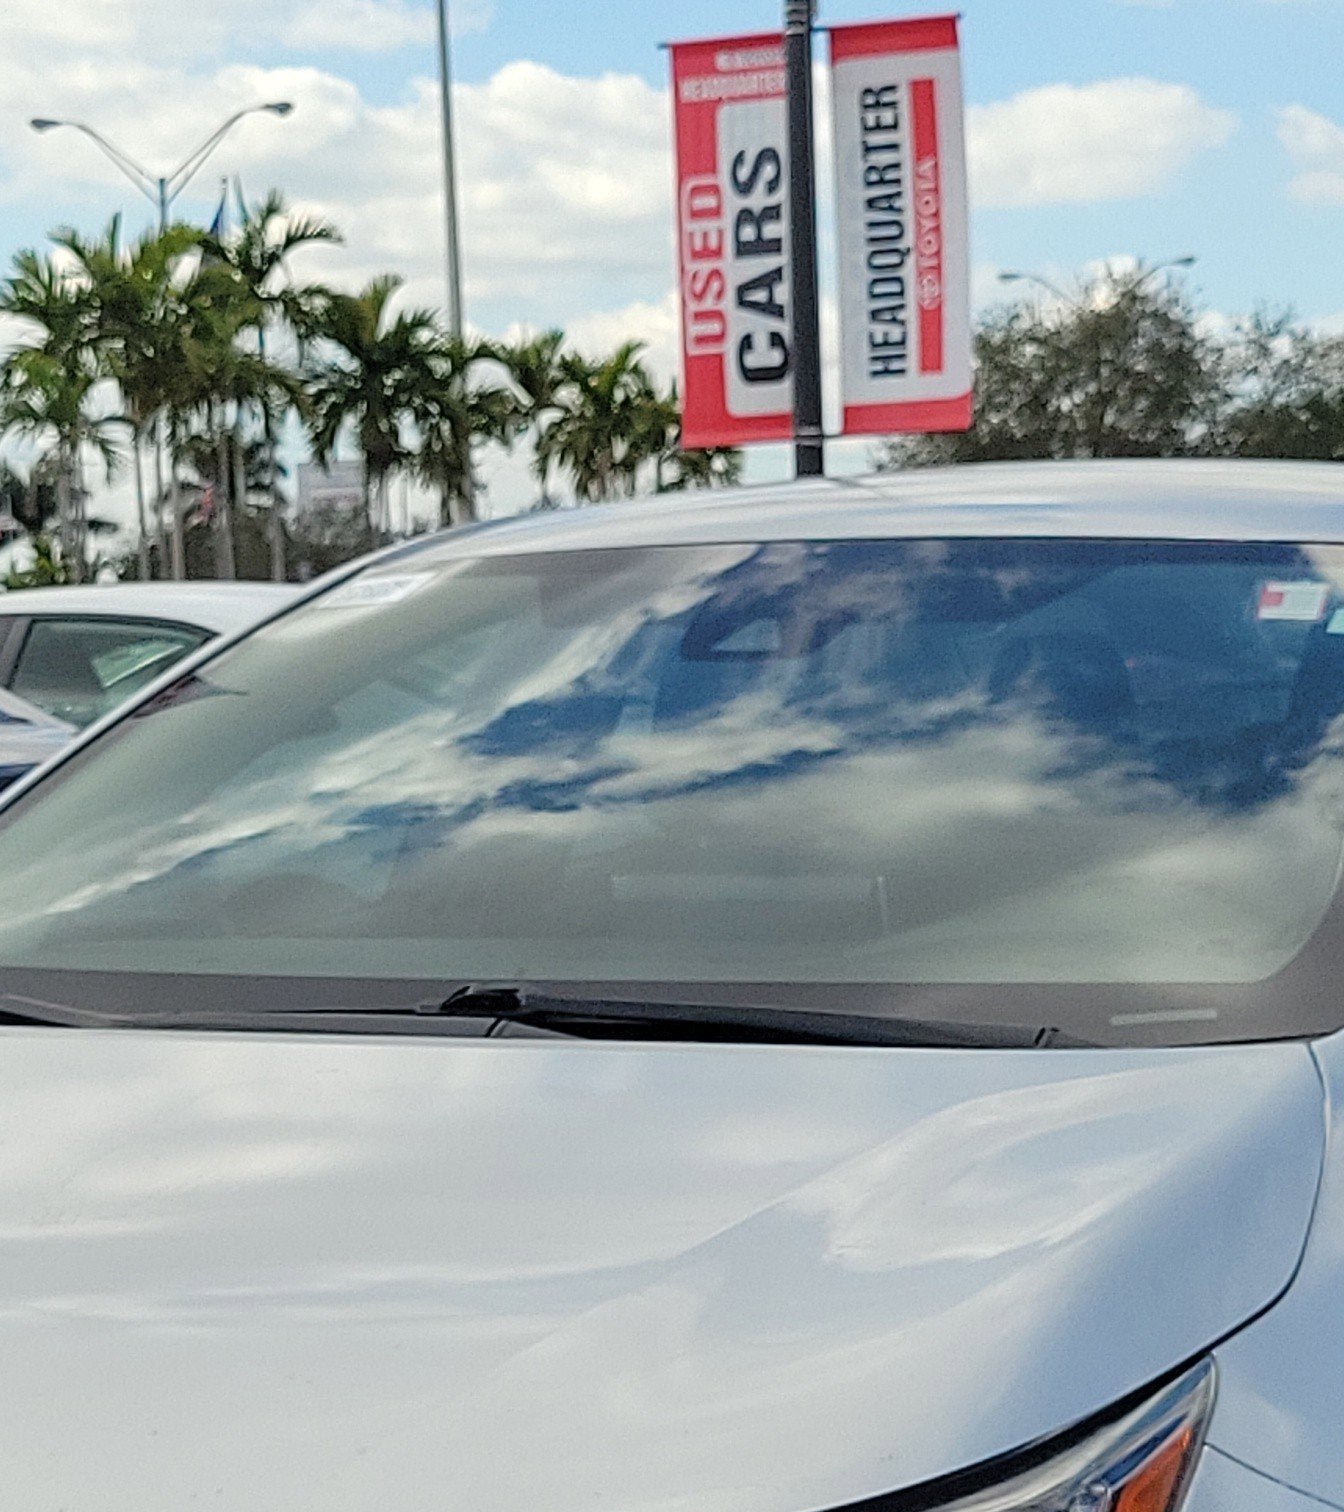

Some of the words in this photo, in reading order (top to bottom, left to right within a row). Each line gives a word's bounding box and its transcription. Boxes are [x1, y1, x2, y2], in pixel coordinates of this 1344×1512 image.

[689, 182, 726, 346] USED
[732, 147, 788, 382] CARS
[861, 85, 910, 377] HEADQUARTER
